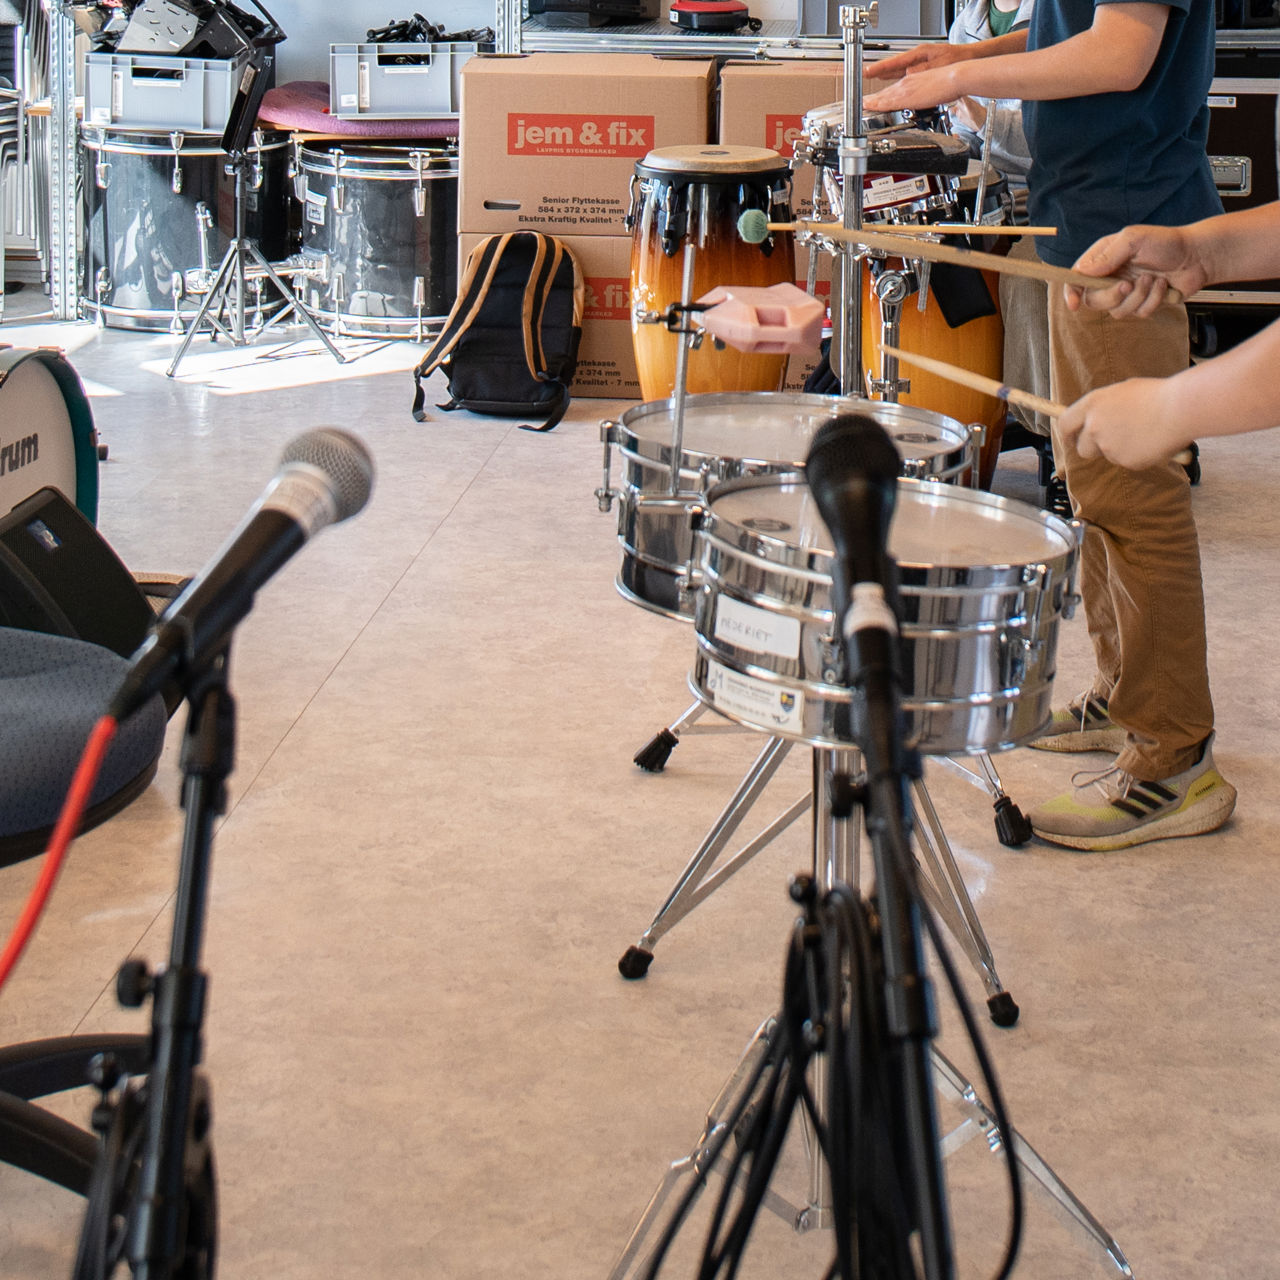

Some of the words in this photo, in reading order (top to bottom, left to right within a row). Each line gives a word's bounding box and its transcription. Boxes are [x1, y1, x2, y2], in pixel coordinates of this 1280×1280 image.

[515, 120, 573, 149] jem
[579, 122, 603, 145] &
[607, 122, 646, 146] fix
[773, 121, 804, 150] je
[542, 196, 570, 204] Senior
[572, 196, 620, 205] Flyttekasse
[548, 215, 576, 224] Kraftig
[580, 216, 612, 224] Kvalitet
